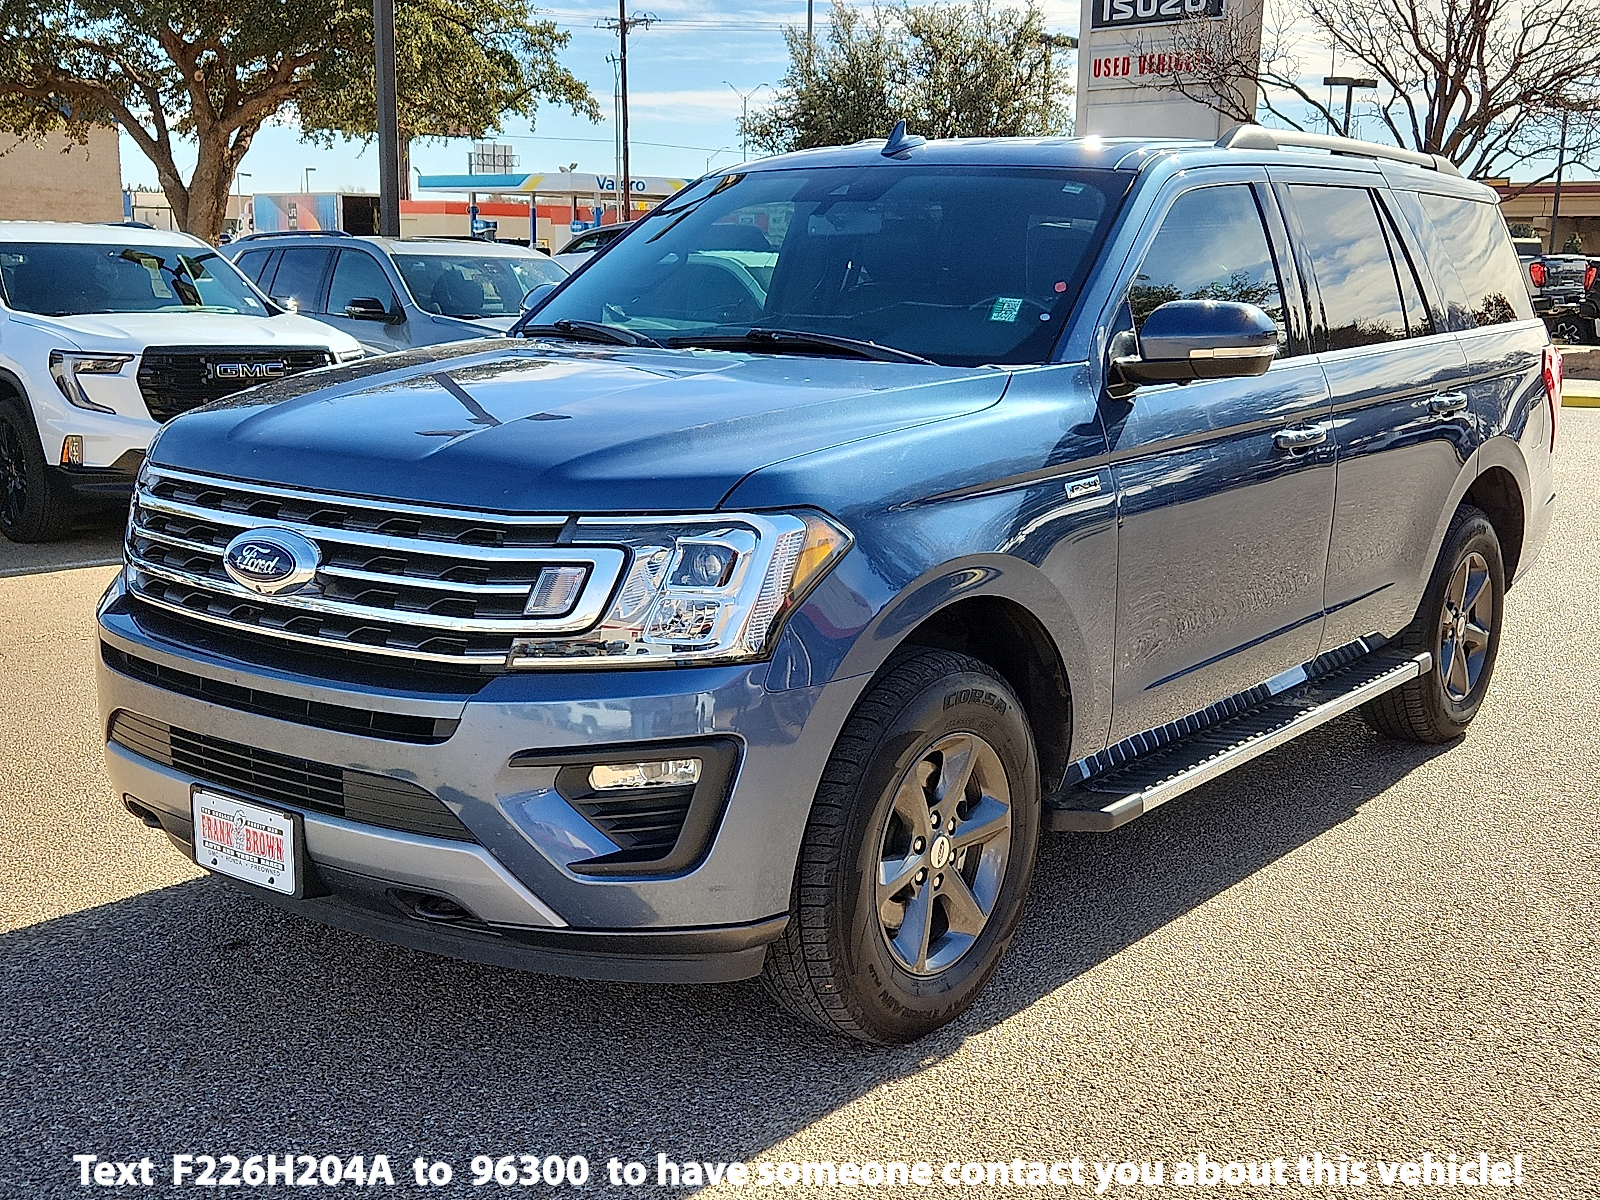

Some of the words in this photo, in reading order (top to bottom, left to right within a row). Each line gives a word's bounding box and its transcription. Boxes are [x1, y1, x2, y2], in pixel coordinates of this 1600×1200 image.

[1093, 56, 1131, 78] USED
[595, 175, 646, 192] Varo
[216, 362, 285, 378] GMC
[236, 544, 280, 575] Ford
[942, 687, 1007, 716] CORSA
[201, 814, 233, 847] FRANK
[245, 827, 284, 862] BROWN
